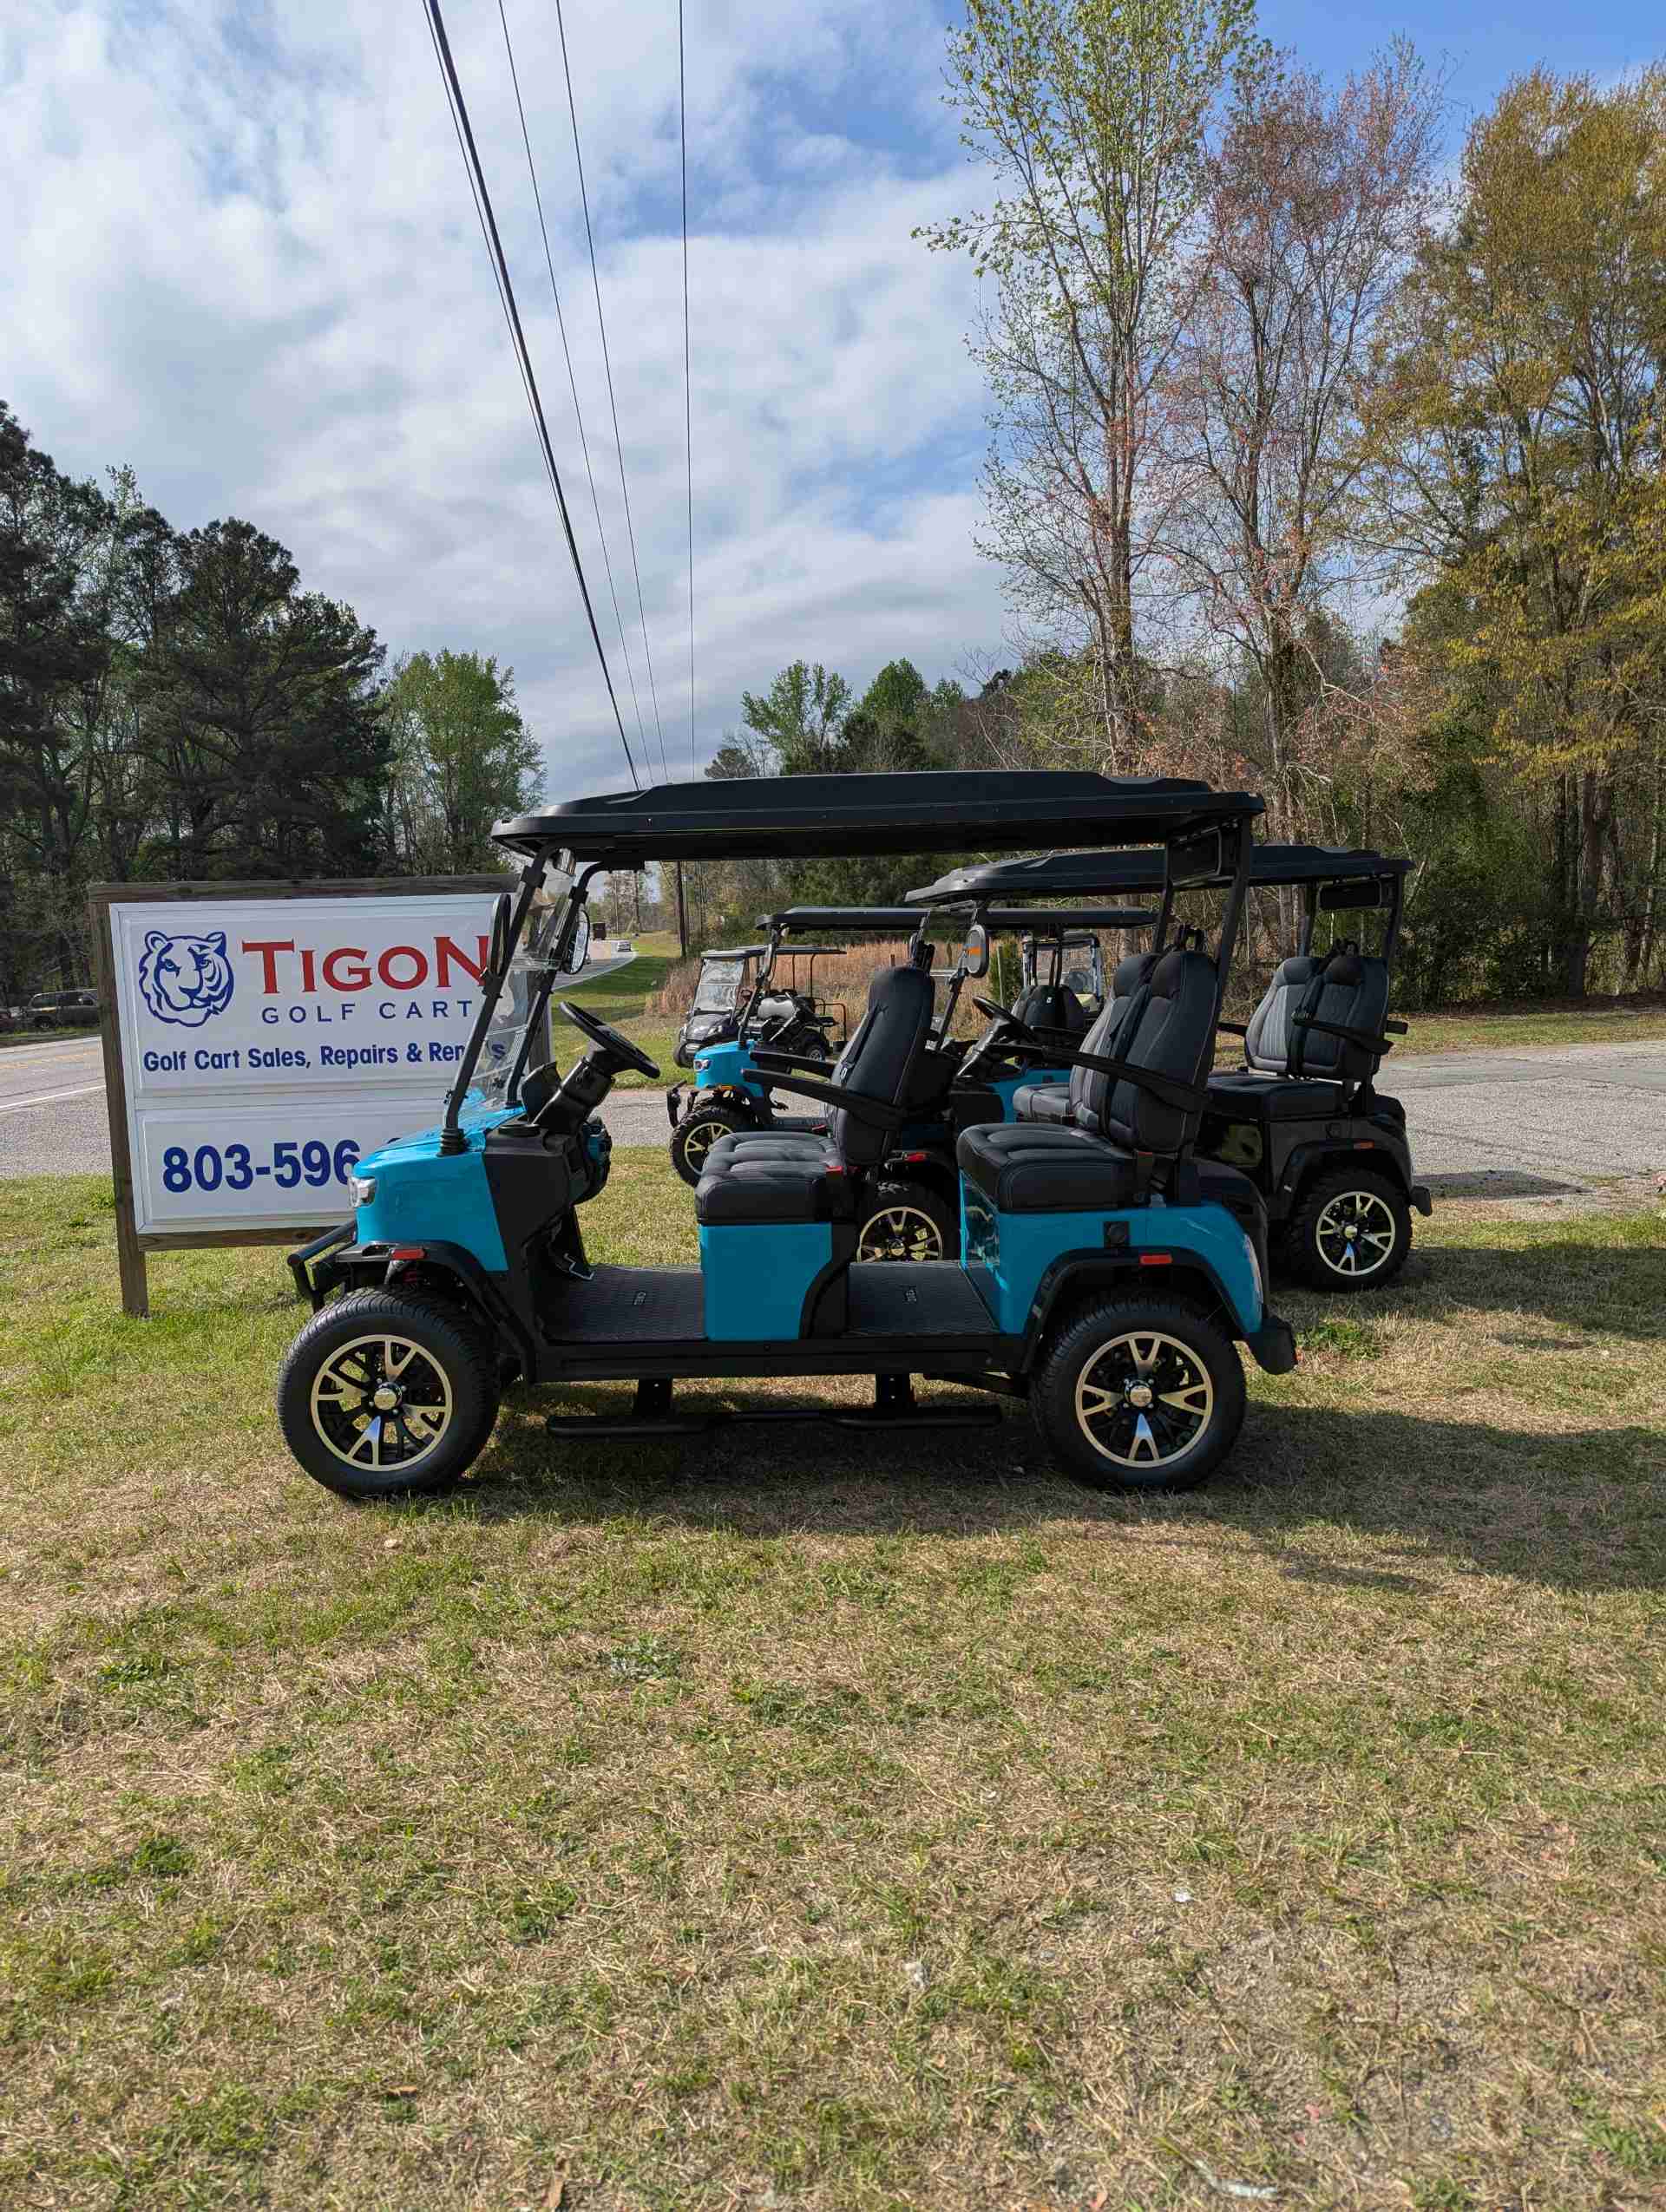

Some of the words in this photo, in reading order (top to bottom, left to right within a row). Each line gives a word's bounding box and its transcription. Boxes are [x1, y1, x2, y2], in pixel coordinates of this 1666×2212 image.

[242, 935, 490, 994] TIGON
[261, 1003, 356, 1024] GOLF
[143, 1050, 187, 1072] Golf
[193, 1049, 240, 1070] Cart
[247, 1047, 311, 1069] Sales,
[320, 1044, 398, 1069] Repairs
[406, 1043, 423, 1063] &
